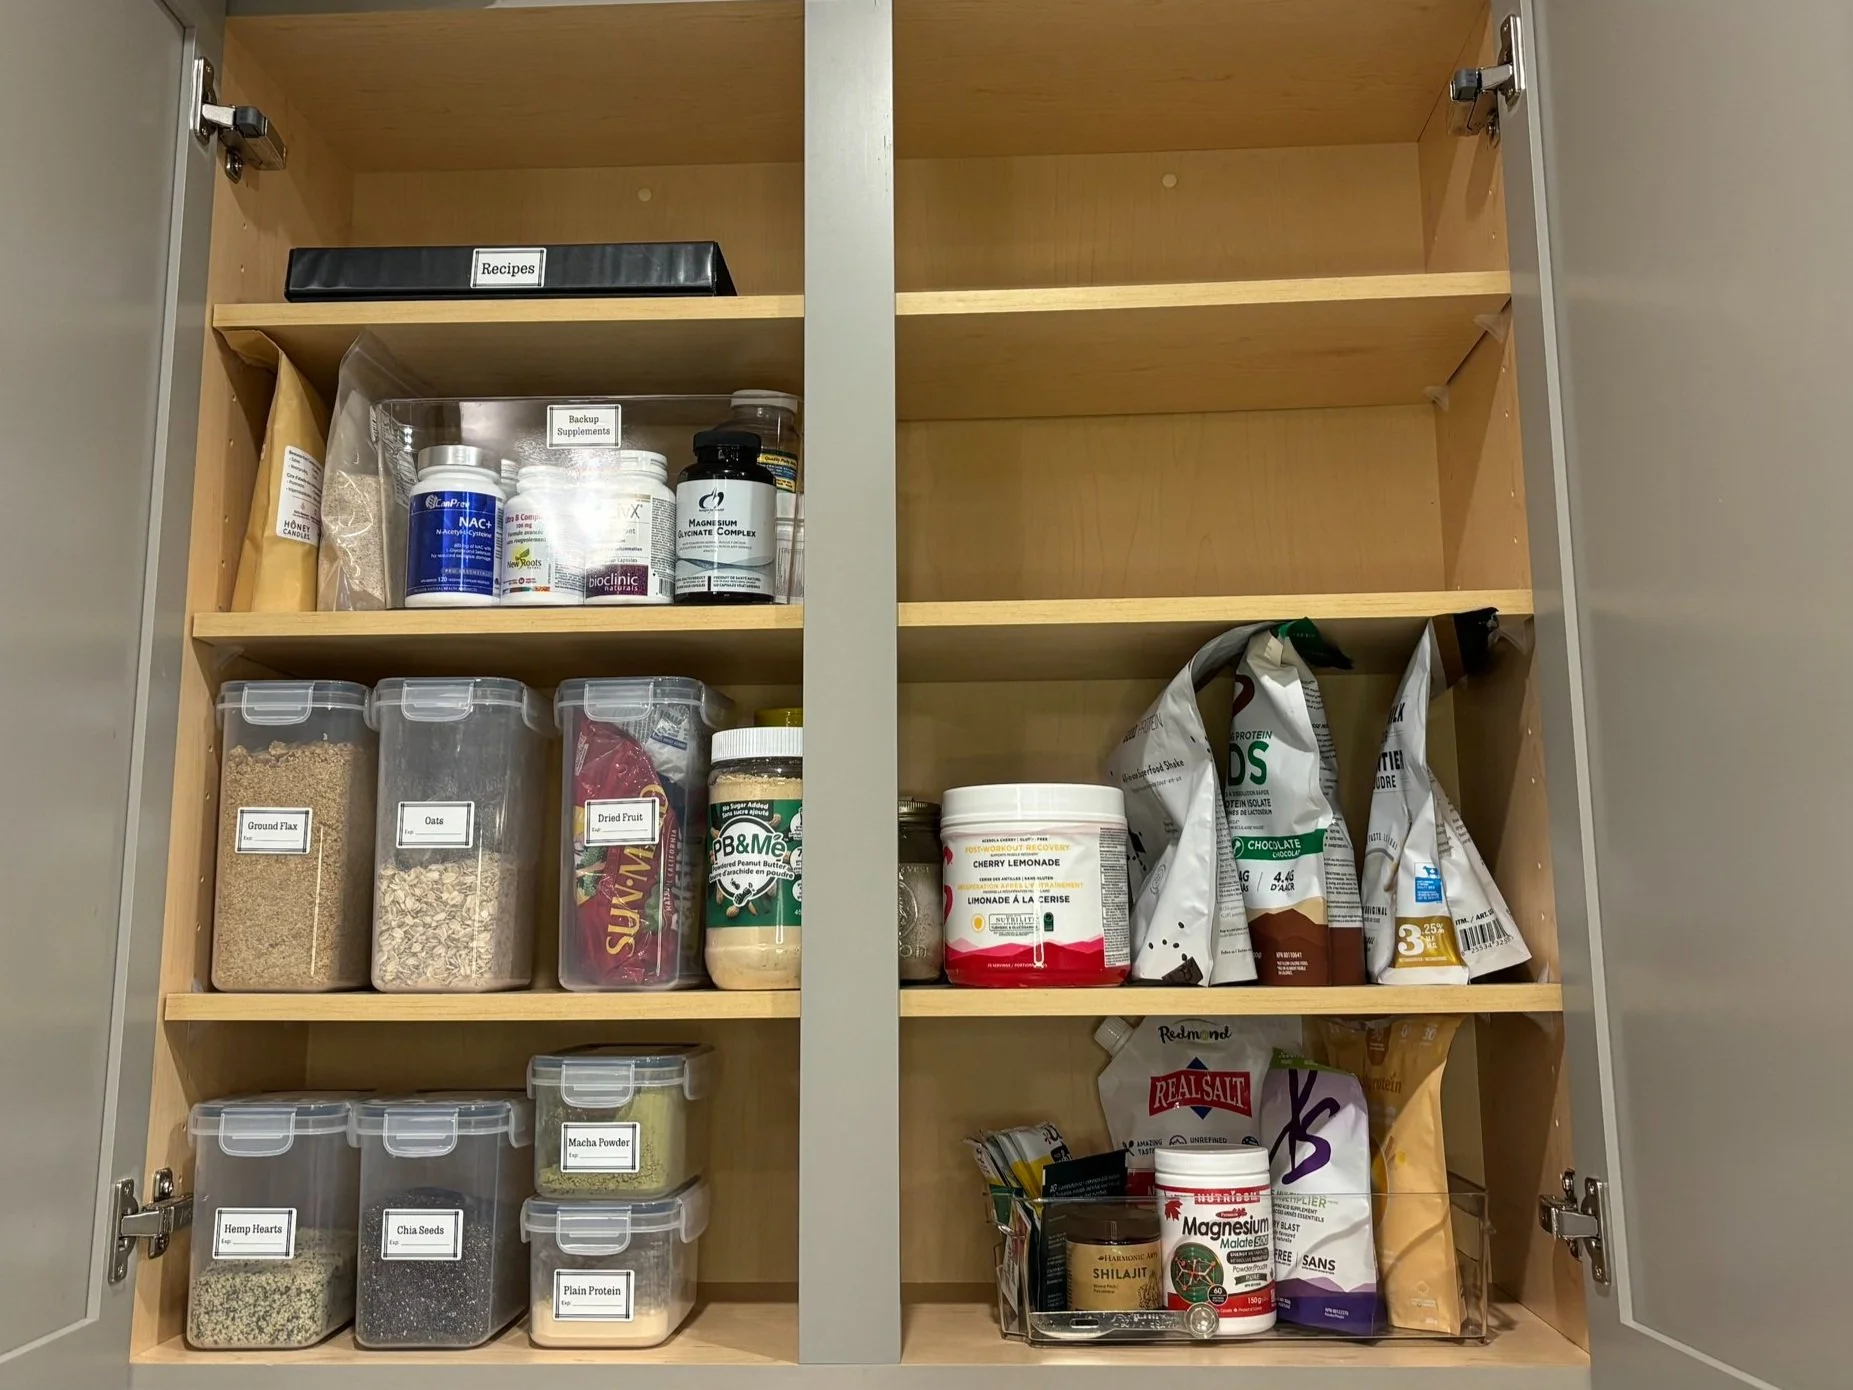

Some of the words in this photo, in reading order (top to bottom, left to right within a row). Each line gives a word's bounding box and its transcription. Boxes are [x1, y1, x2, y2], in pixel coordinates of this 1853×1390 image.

[481, 262, 536, 277] Recipes
[568, 414, 600, 426] Backup
[556, 426, 611, 437] Supplements
[435, 498, 470, 508] CanPrev
[459, 516, 493, 529] NAC+
[688, 519, 738, 528] MAGNESIUM
[282, 528, 311, 541] CANDLES
[677, 529, 713, 539] GLYCINATE
[716, 527, 756, 538] COMPLEX
[507, 560, 520, 569] New
[588, 572, 639, 588] bioclinic
[604, 584, 639, 592] naturals
[1235, 730, 1273, 740] PROTEIN
[1163, 758, 1185, 772] Shake
[747, 802, 769, 810] Added
[1247, 798, 1272, 808] ISOLATE
[597, 812, 621, 823] Dried
[622, 811, 644, 823] Fruit
[749, 808, 769, 817] ajouté
[247, 821, 278, 831] Ground
[279, 821, 298, 831] Flax
[424, 816, 444, 826] Oats
[964, 845, 1023, 854] POST-WORKOUT
[1025, 844, 1070, 853] RECOVERY
[1247, 838, 1302, 850] CHOCOLATE
[667, 828, 678, 878] CALIFORNIA
[762, 860, 789, 870] Butter
[972, 859, 1006, 869] CHERRY
[1007, 858, 1061, 868] LEMONADE
[722, 866, 754, 877] d'arachide
[766, 869, 794, 880] poudre
[967, 896, 1010, 905] LIMONADE
[1022, 896, 1034, 904] LA
[1038, 895, 1071, 904] CERISE
[1455, 917, 1469, 926] ITM.
[1475, 913, 1489, 922] ART.
[1397, 924, 1425, 956] 3
[1158, 1025, 1232, 1044] Redmond
[1153, 1074, 1201, 1109] REAL
[1202, 1075, 1246, 1109] SALT
[568, 1137, 597, 1147] Macha
[598, 1137, 631, 1148] Powder
[1136, 1138, 1163, 1148] AMAZING
[1189, 1136, 1228, 1144] UNREFINED
[1290, 1206, 1318, 1216] SUPPLEMENT
[1297, 1212, 1325, 1223] ESSENTIELS
[223, 1223, 251, 1236] Hemp
[252, 1223, 283, 1234] Hearts
[396, 1224, 418, 1235] Chia
[418, 1224, 445, 1235] Seeds
[1181, 1214, 1269, 1241] Magnesium
[1280, 1221, 1301, 1233] BLAST
[1219, 1237, 1255, 1249] Malate
[1104, 1254, 1144, 1263] HARMONIC
[1274, 1248, 1292, 1263] FREE
[1302, 1254, 1336, 1271] SANS
[1092, 1266, 1149, 1280] SHILAJIT
[563, 1285, 587, 1296] Plain
[588, 1285, 622, 1296] Protein
